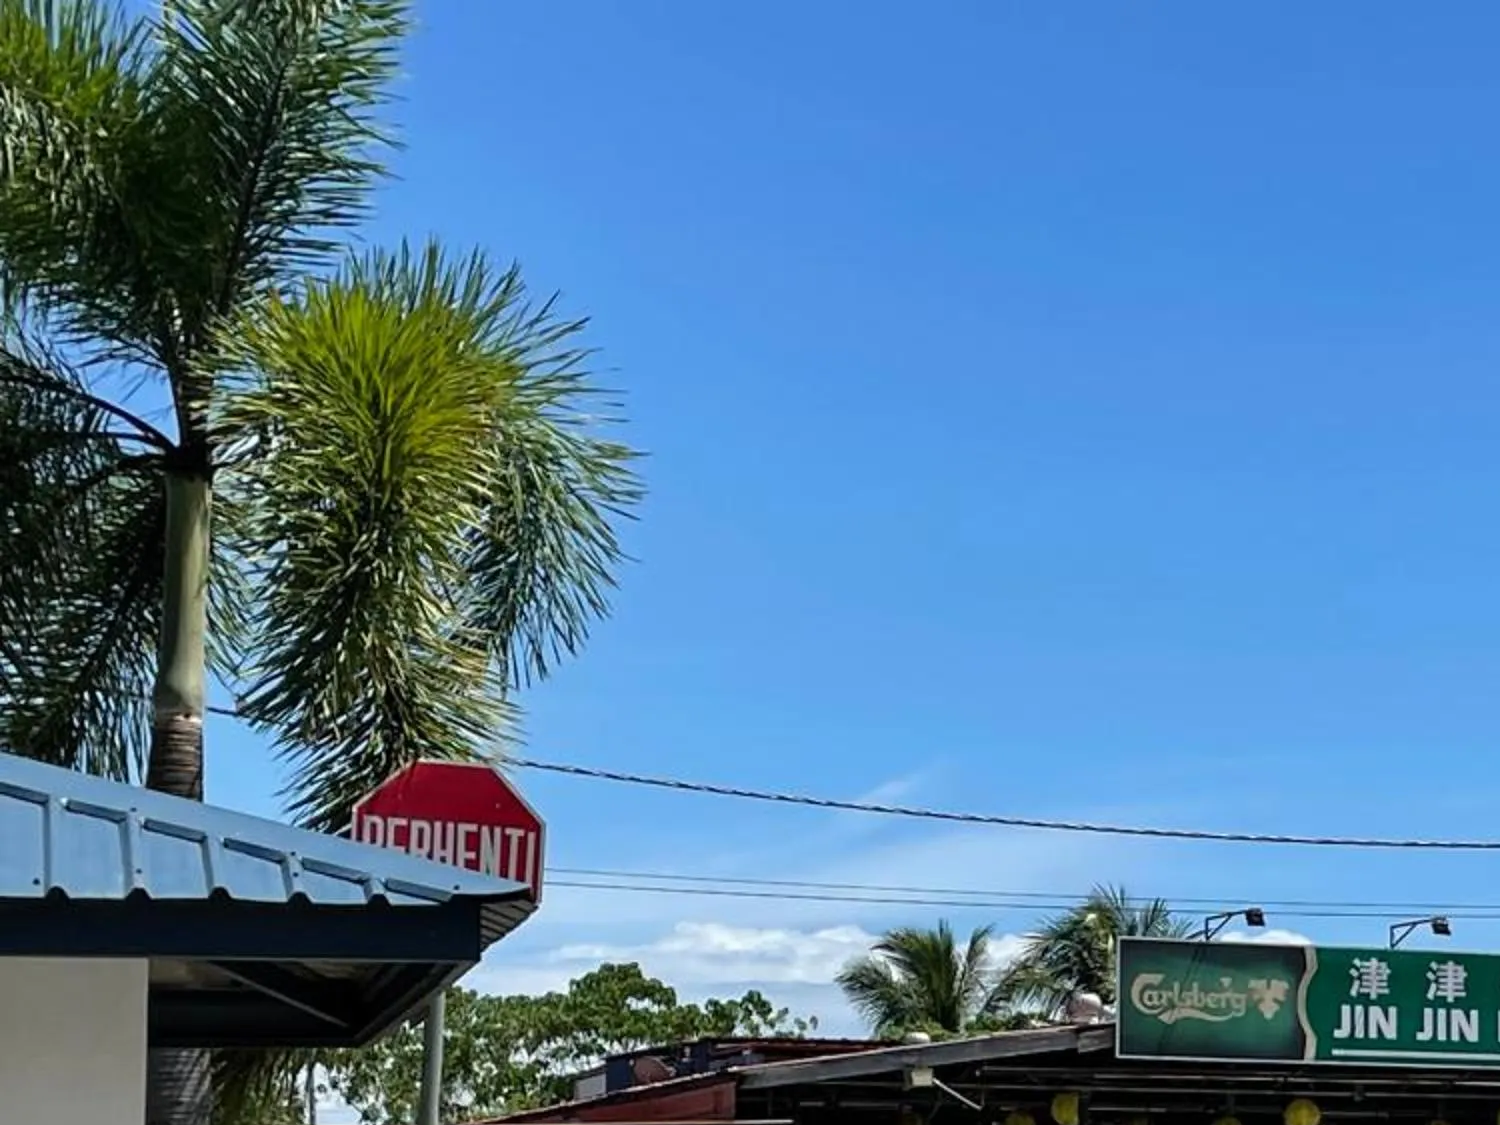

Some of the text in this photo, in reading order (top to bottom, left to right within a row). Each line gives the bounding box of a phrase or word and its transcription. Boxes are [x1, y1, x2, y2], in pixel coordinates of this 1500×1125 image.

[1131, 973, 1248, 1025] Carlsberg
[1333, 1004, 1397, 1041] JIN
[1416, 1007, 1479, 1043] JIN
